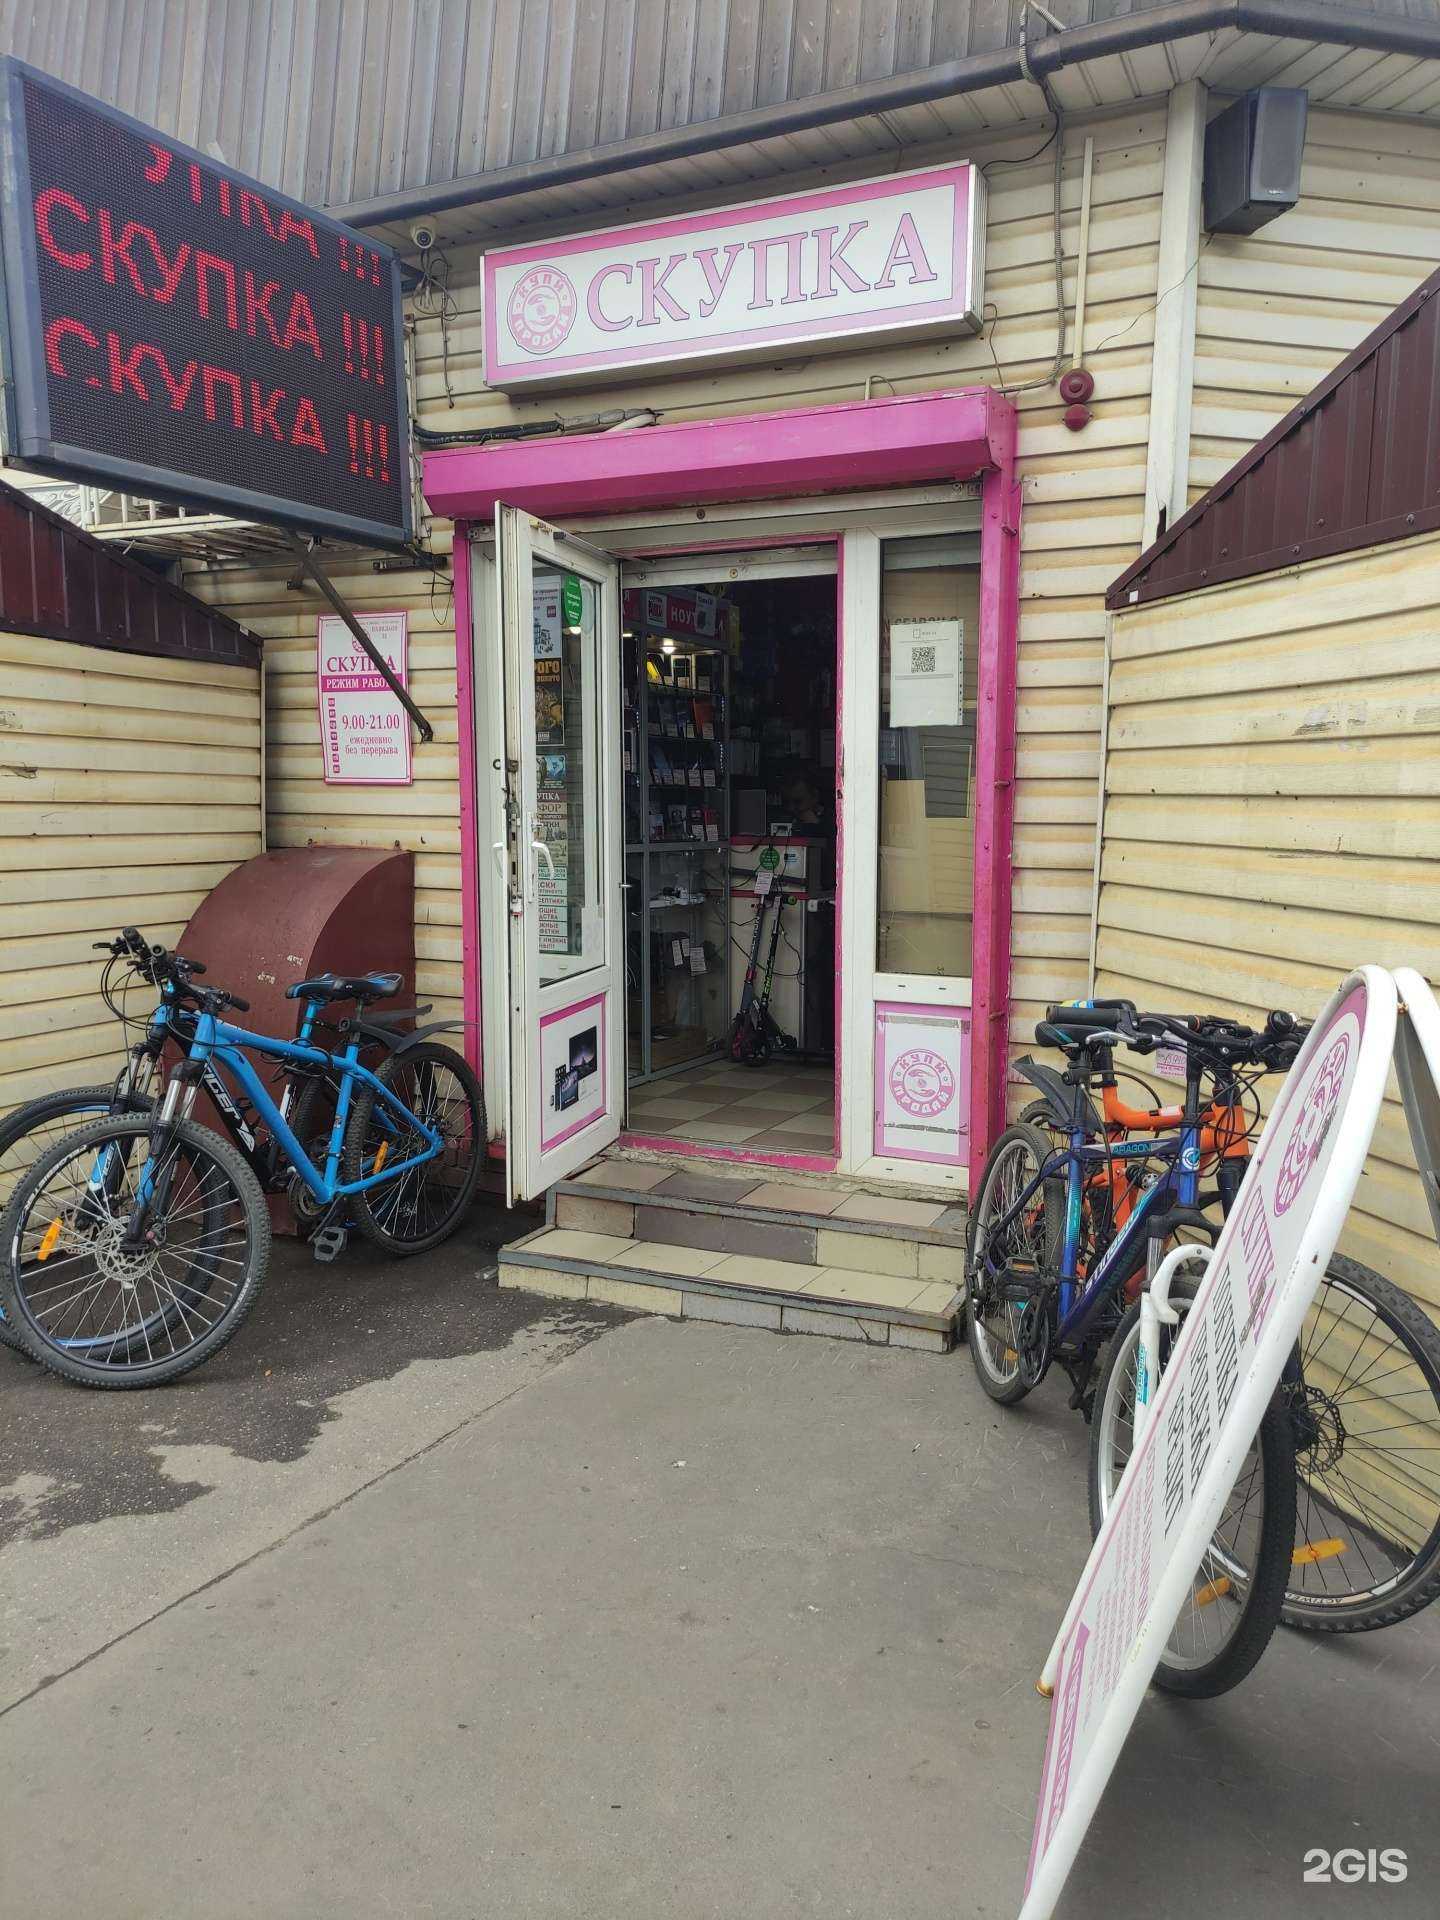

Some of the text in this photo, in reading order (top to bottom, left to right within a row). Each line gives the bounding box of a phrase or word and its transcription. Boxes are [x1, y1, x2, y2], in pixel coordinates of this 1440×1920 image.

[34, 186, 385, 385] СКУПКА !!!
[586, 212, 938, 332] СКУПКА
[44, 316, 390, 482] СКУПКА !!!
[326, 678, 359, 689] РЕЖИМ
[327, 655, 396, 672] СКУПА
[342, 714, 400, 730] 9.00-21.00
[345, 745, 399, 757] без перерыва
[350, 736, 393, 745] ежедневно
[899, 1054, 946, 1074] КУПИ
[1212, 1261, 1240, 1430] ПОКУПКА
[1187, 1315, 1212, 1499] ПРОДАЖА
[1163, 1383, 1185, 1543] КРЕДИТ
